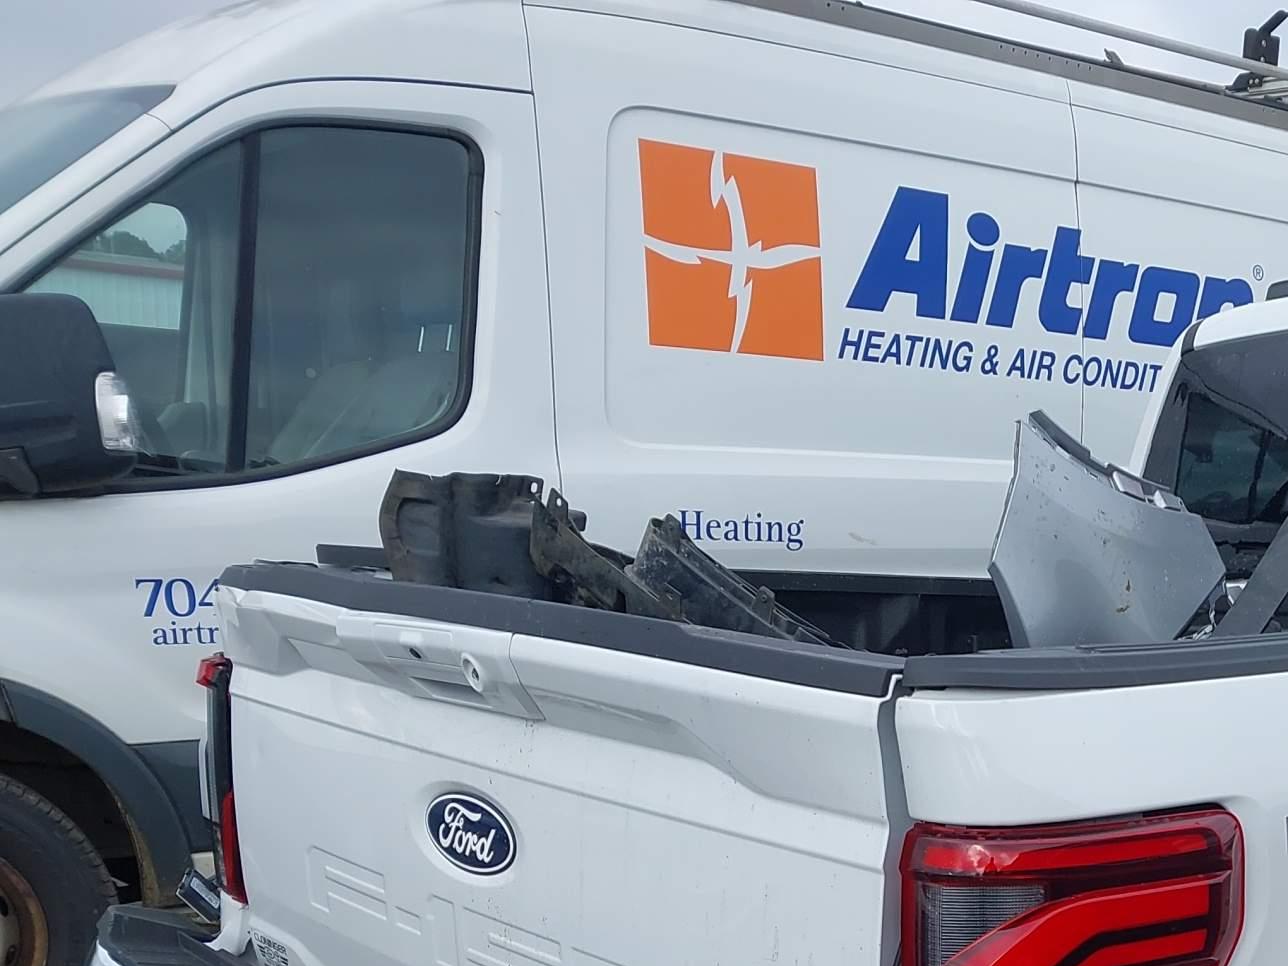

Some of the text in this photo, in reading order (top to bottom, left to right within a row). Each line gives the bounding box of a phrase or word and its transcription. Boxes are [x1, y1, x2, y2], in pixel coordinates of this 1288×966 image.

[838, 328, 1164, 393] HEATING & AIR CONDIT
[678, 509, 804, 551] Heating
[152, 621, 219, 645] airtr
[439, 802, 496, 863] Ford
